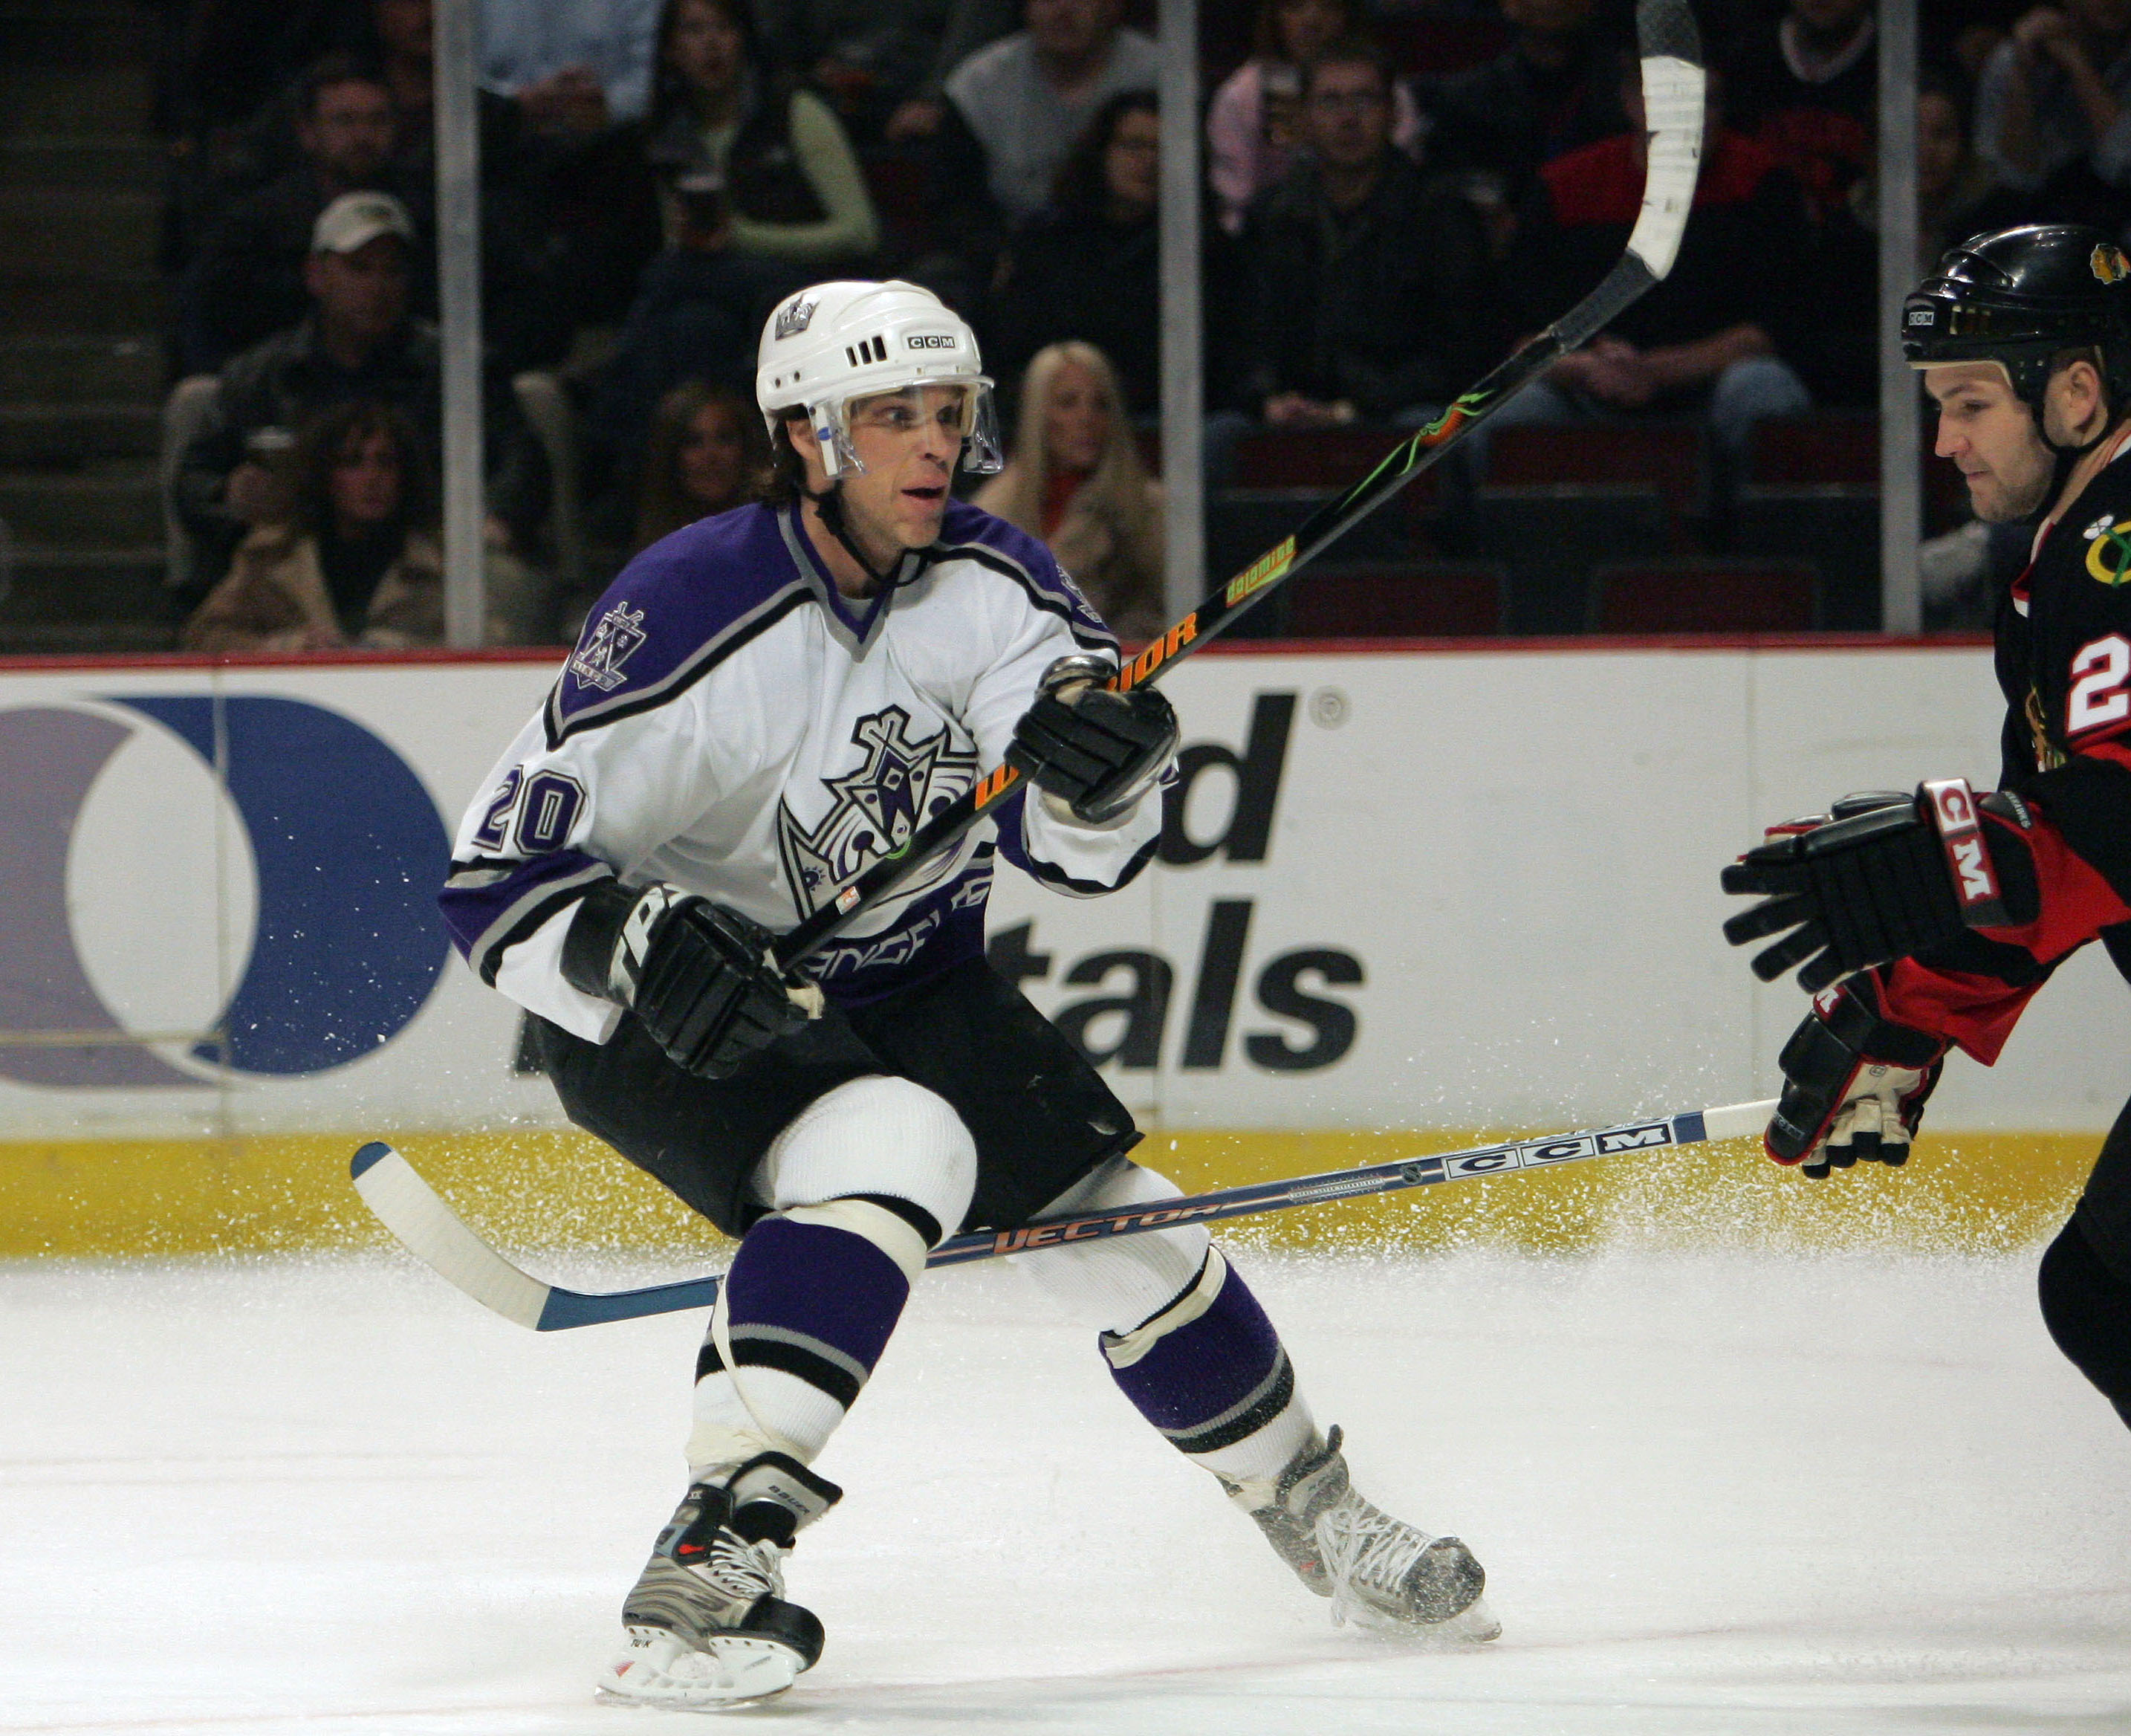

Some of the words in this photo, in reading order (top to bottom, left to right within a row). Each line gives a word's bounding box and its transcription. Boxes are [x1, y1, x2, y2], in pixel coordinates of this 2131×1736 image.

[1908, 311, 1933, 325] CCM
[909, 337, 954, 348] CCM
[2067, 634, 2131, 737] 2
[470, 764, 586, 855] 20
[1457, 1125, 1667, 1173] CCM
